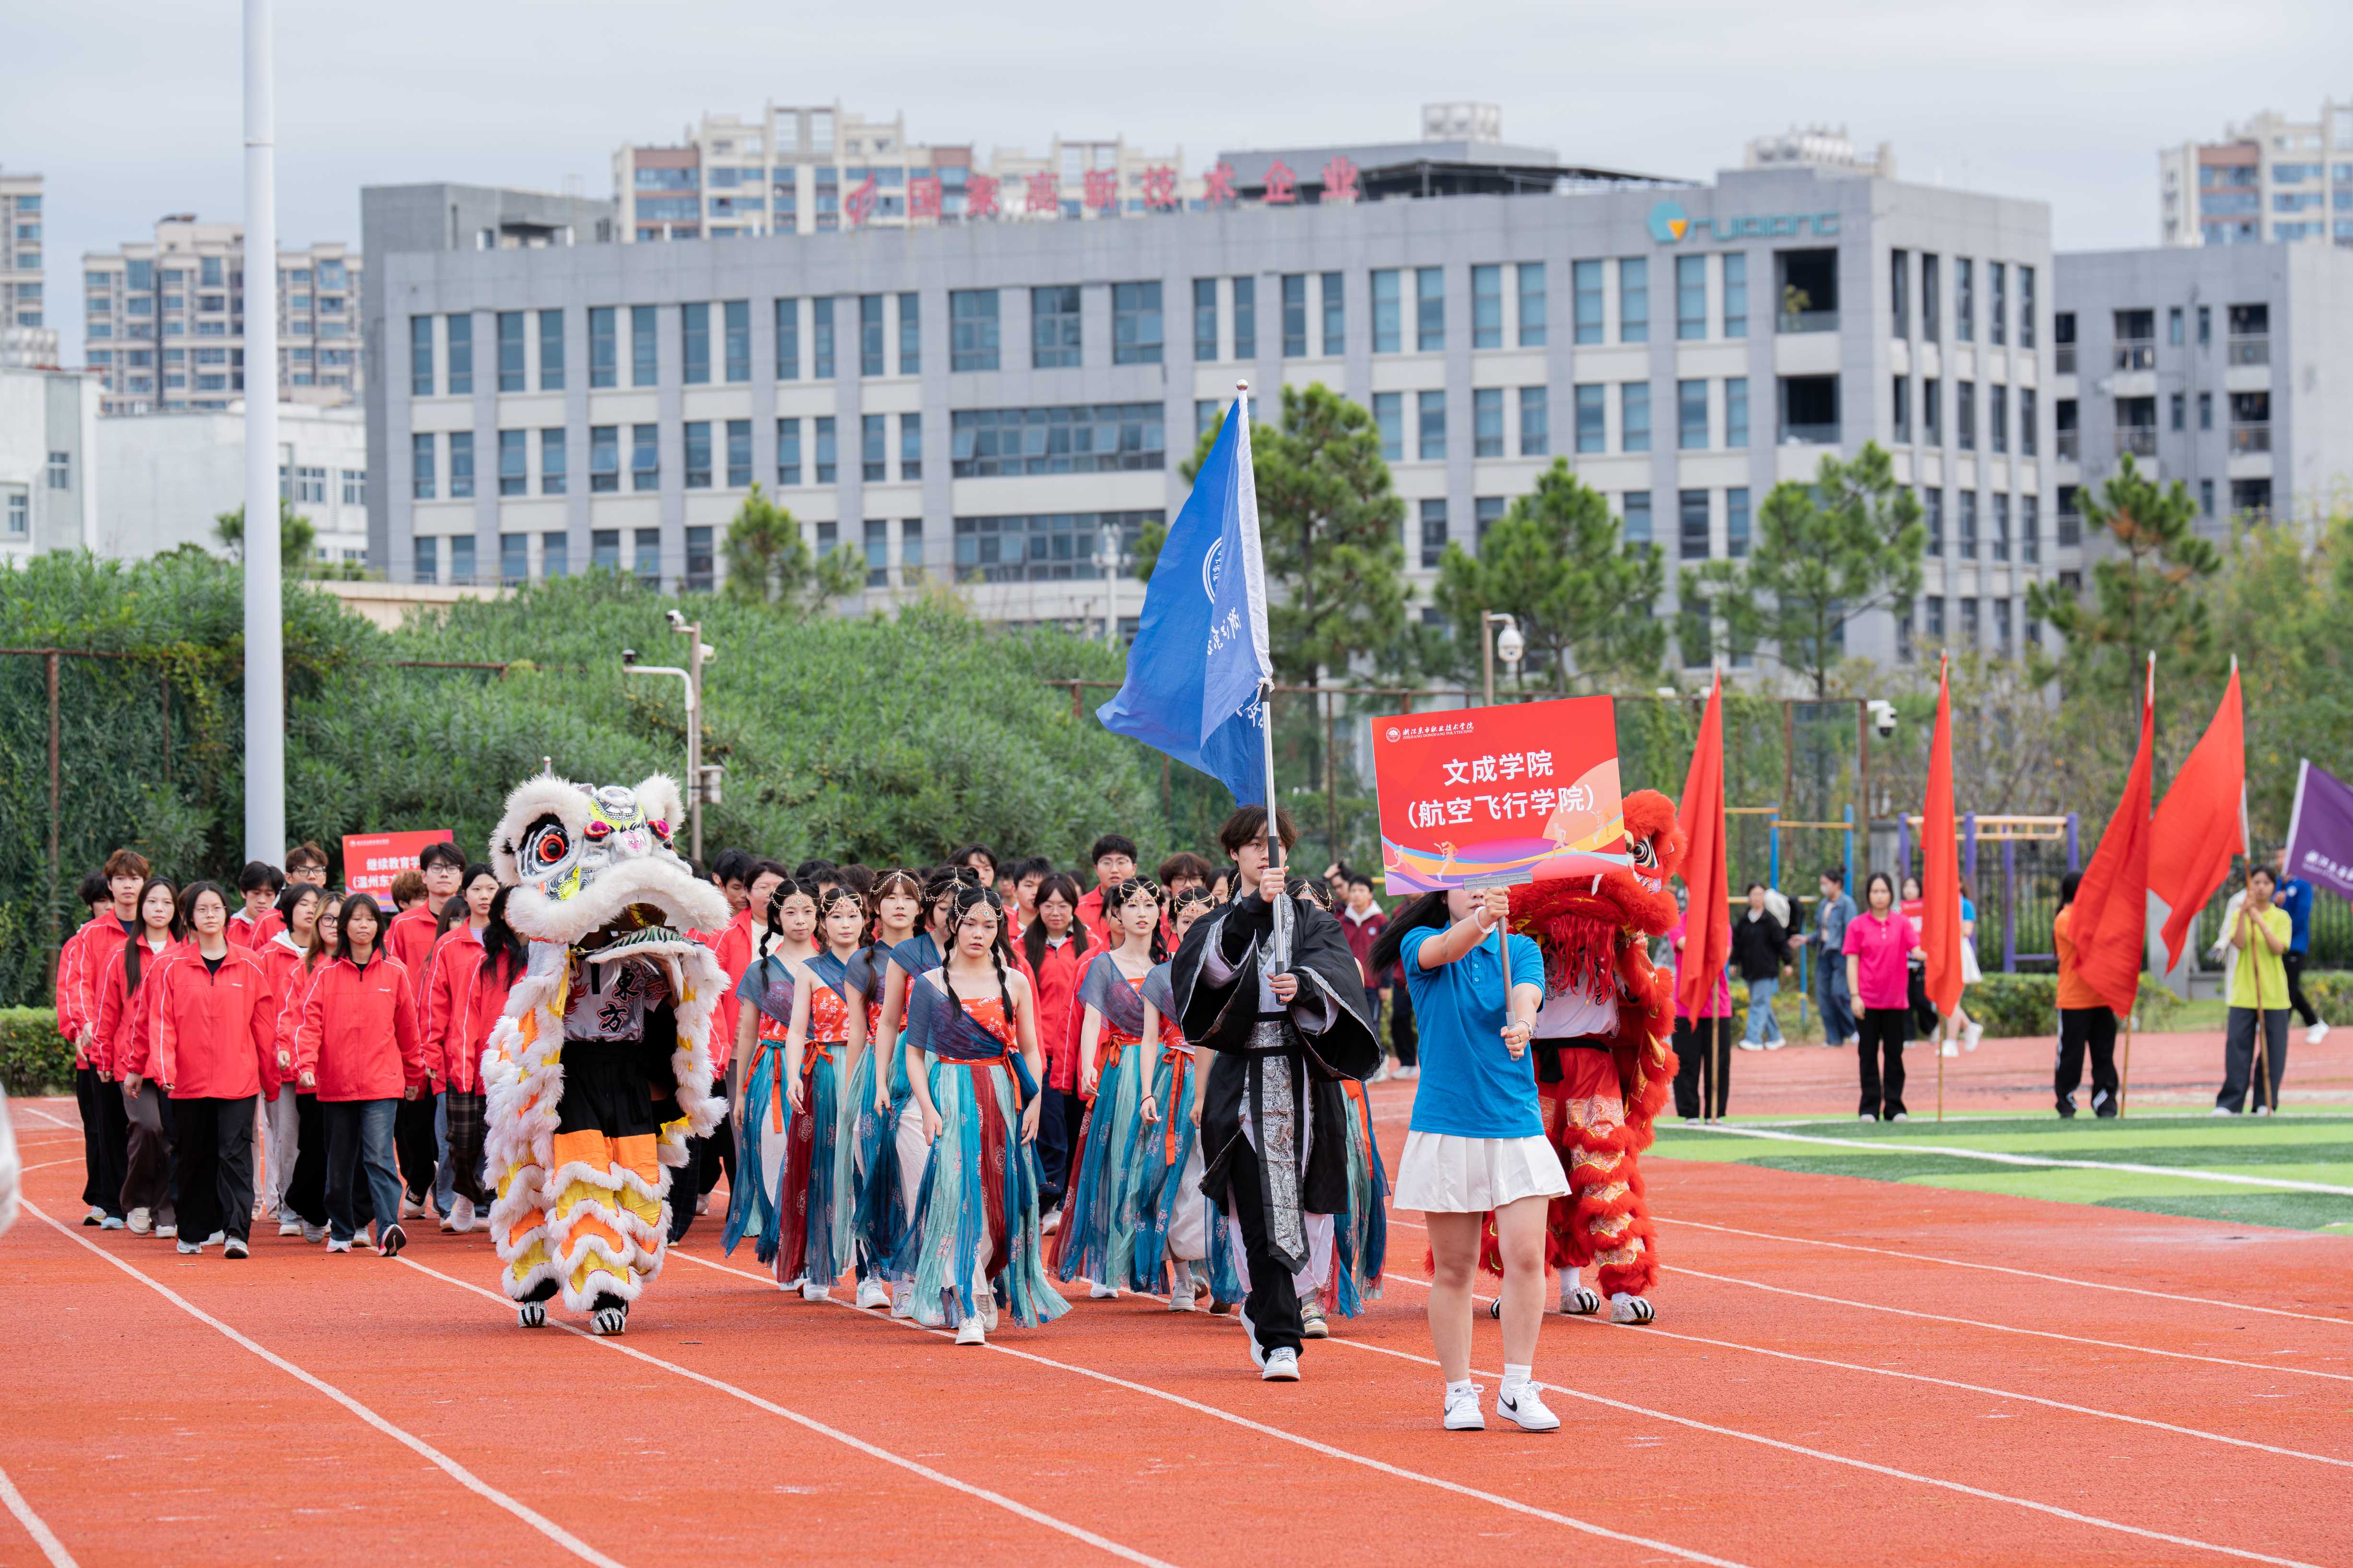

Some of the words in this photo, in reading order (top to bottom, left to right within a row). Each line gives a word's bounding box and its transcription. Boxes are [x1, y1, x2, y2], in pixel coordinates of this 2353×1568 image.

[907, 156, 1359, 220] 国家高新技术企业
[1442, 749, 1553, 786] 文成学院
[1408, 784, 1594, 829] （航空飞行学院）
